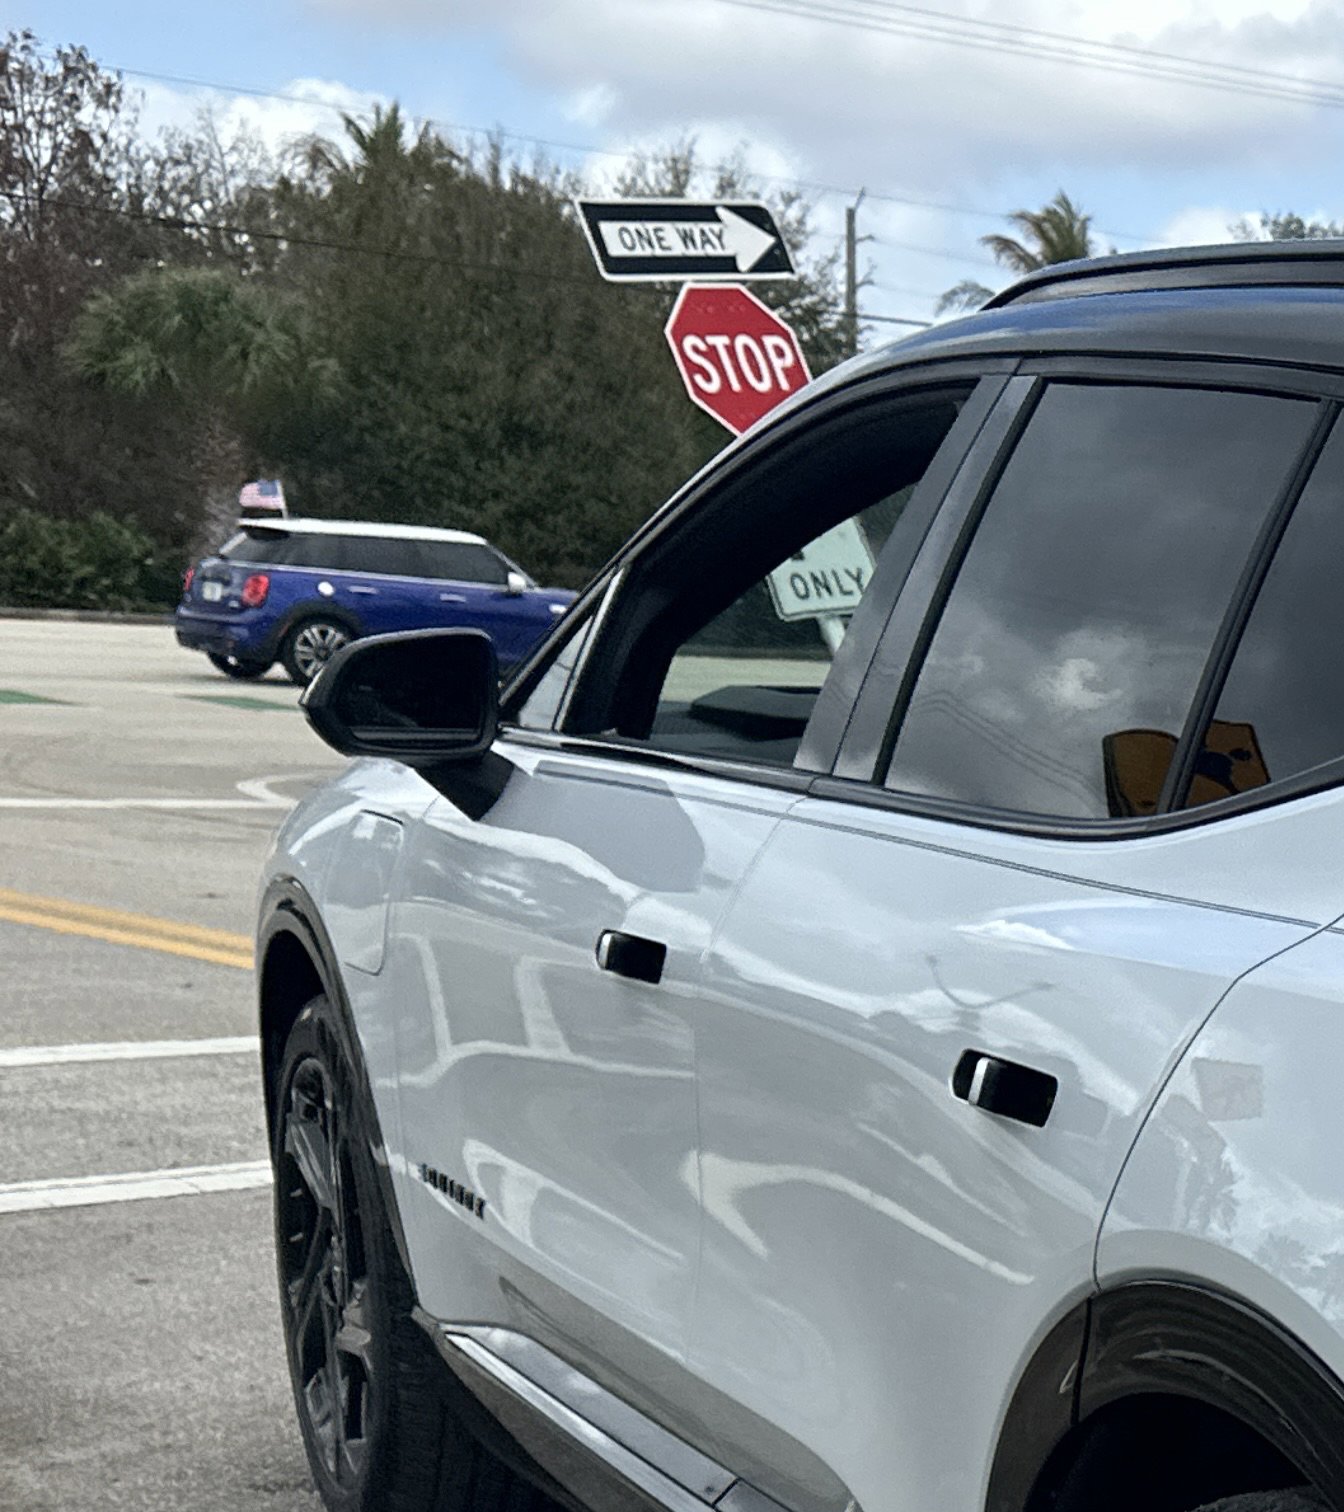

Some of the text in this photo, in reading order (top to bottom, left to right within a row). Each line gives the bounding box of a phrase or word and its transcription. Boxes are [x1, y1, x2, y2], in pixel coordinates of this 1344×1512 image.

[617, 225, 727, 252] ONE WAY
[682, 334, 794, 394] STOP
[790, 567, 866, 600] ONLY
